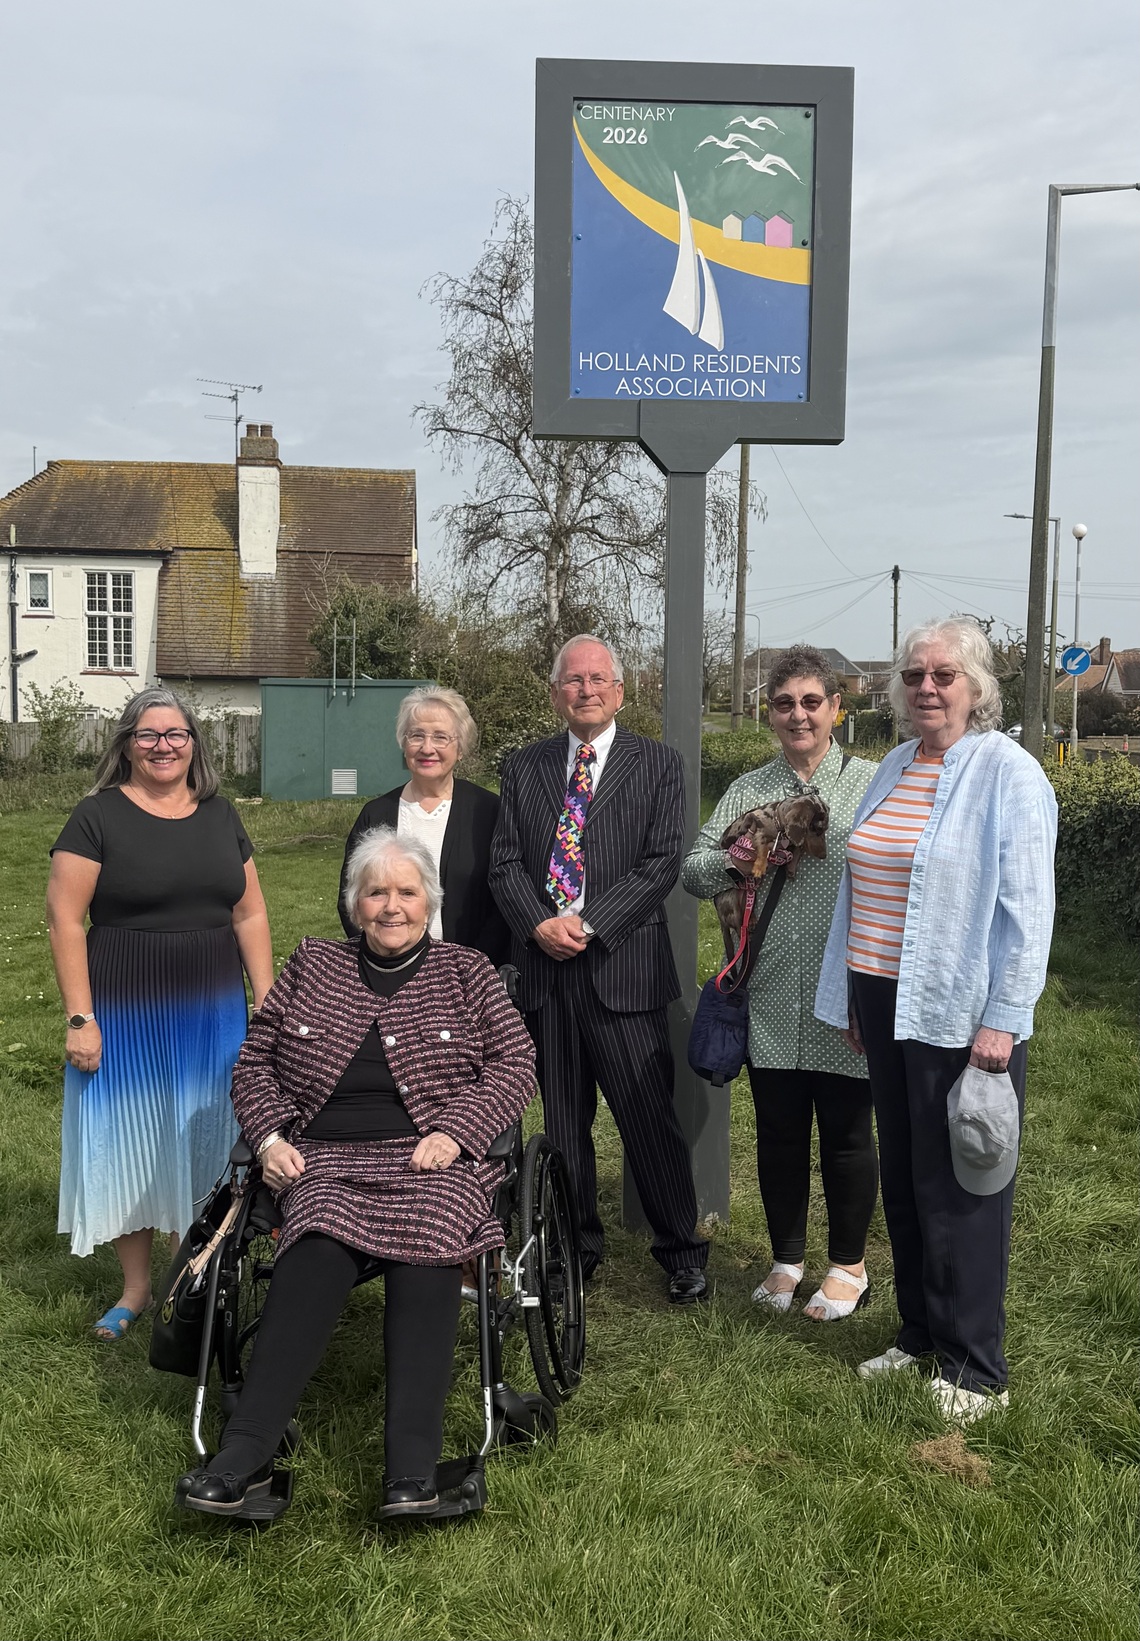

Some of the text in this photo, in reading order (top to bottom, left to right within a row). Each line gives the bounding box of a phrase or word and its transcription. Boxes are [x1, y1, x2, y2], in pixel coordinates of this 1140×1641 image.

[580, 105, 676, 121] CENTENARY
[602, 126, 648, 145] 2026
[579, 351, 801, 375] HOLLAND RESIDENTS
[615, 376, 766, 397] ASSOCIATION
